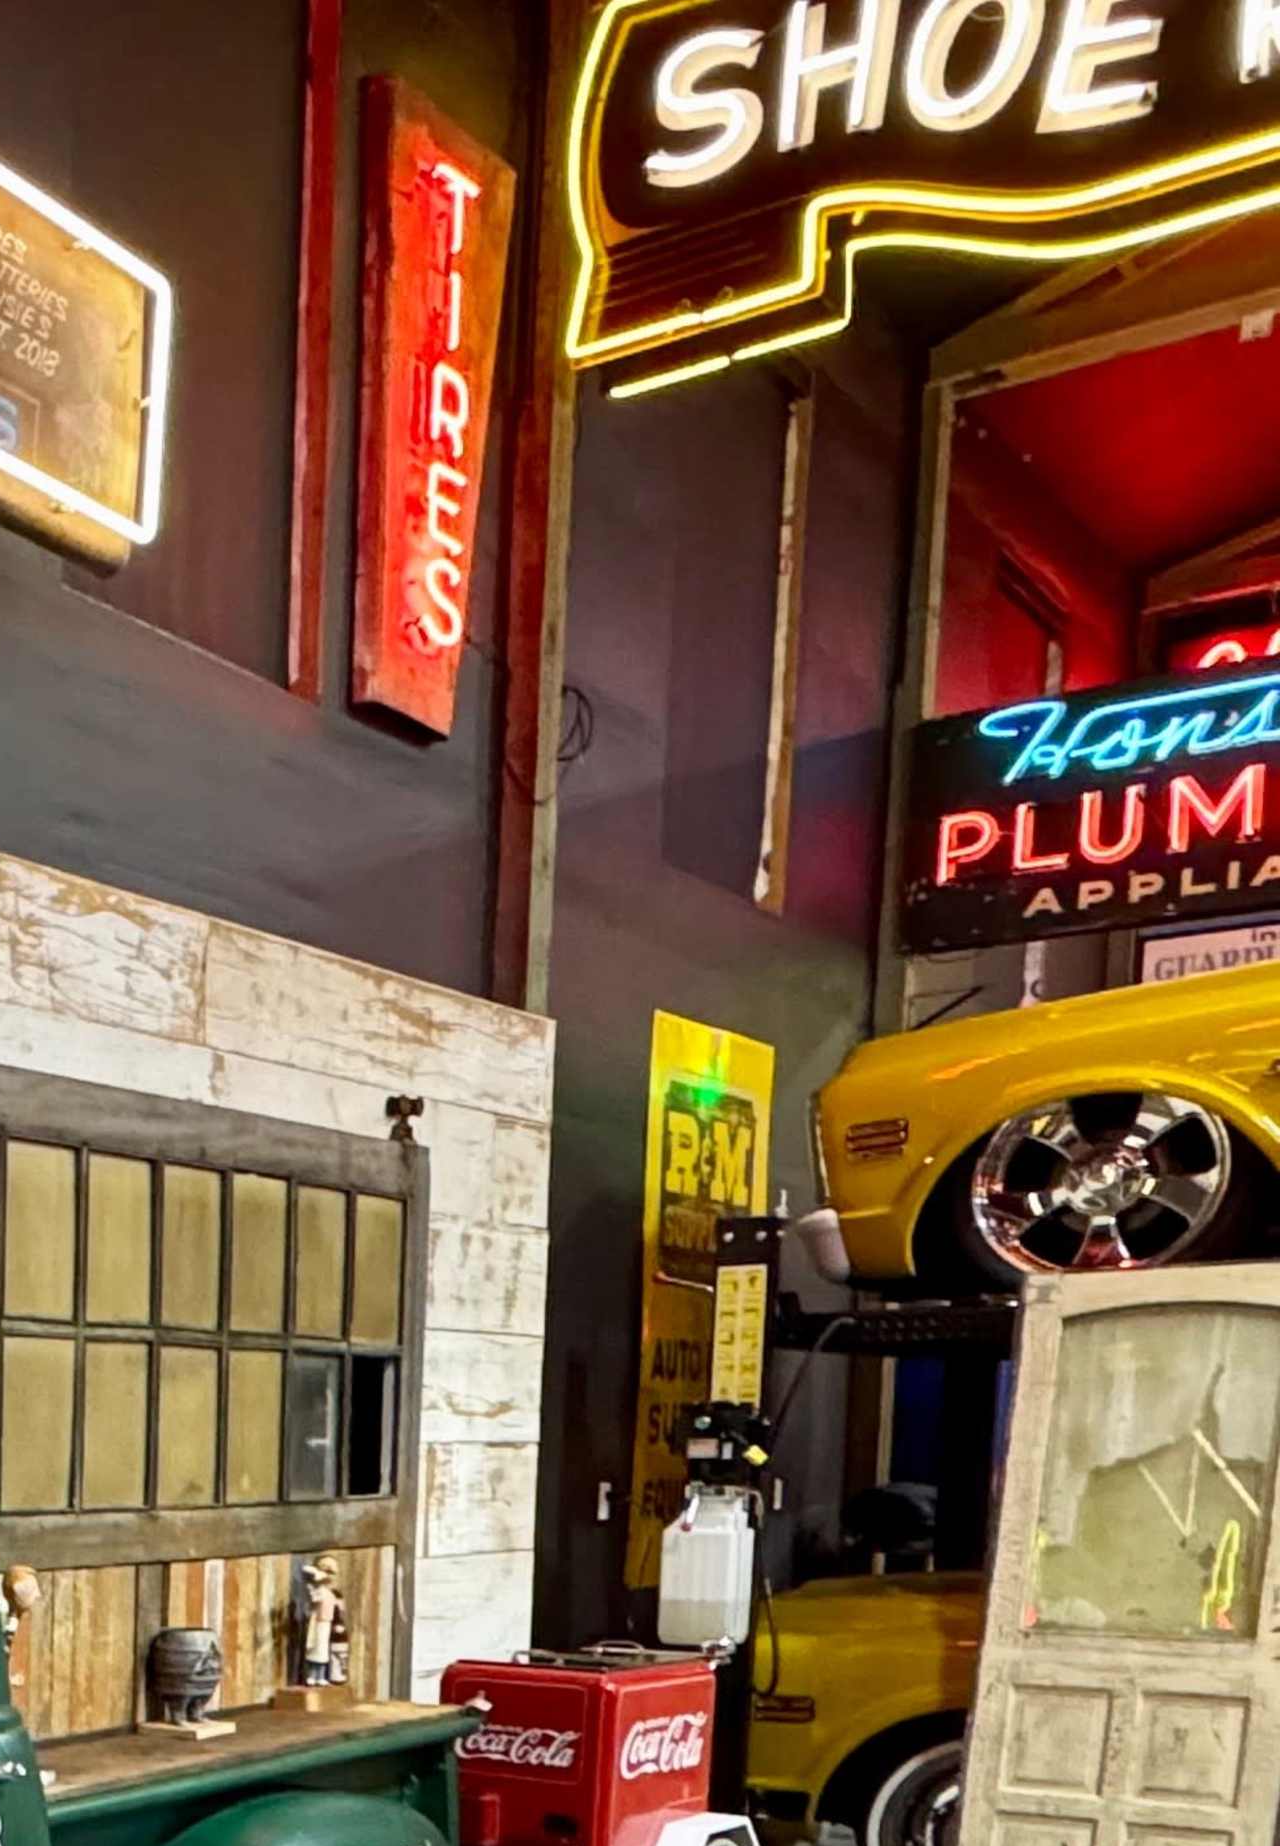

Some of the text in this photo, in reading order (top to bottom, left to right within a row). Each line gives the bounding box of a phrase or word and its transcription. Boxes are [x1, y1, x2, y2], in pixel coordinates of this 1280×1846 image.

[643, 0, 1164, 188] SHOE
[14, 332, 61, 378] 2018
[421, 161, 481, 649] TIRES
[936, 763, 1267, 887] PLUM
[620, 1711, 708, 1781] Coca-Cola
